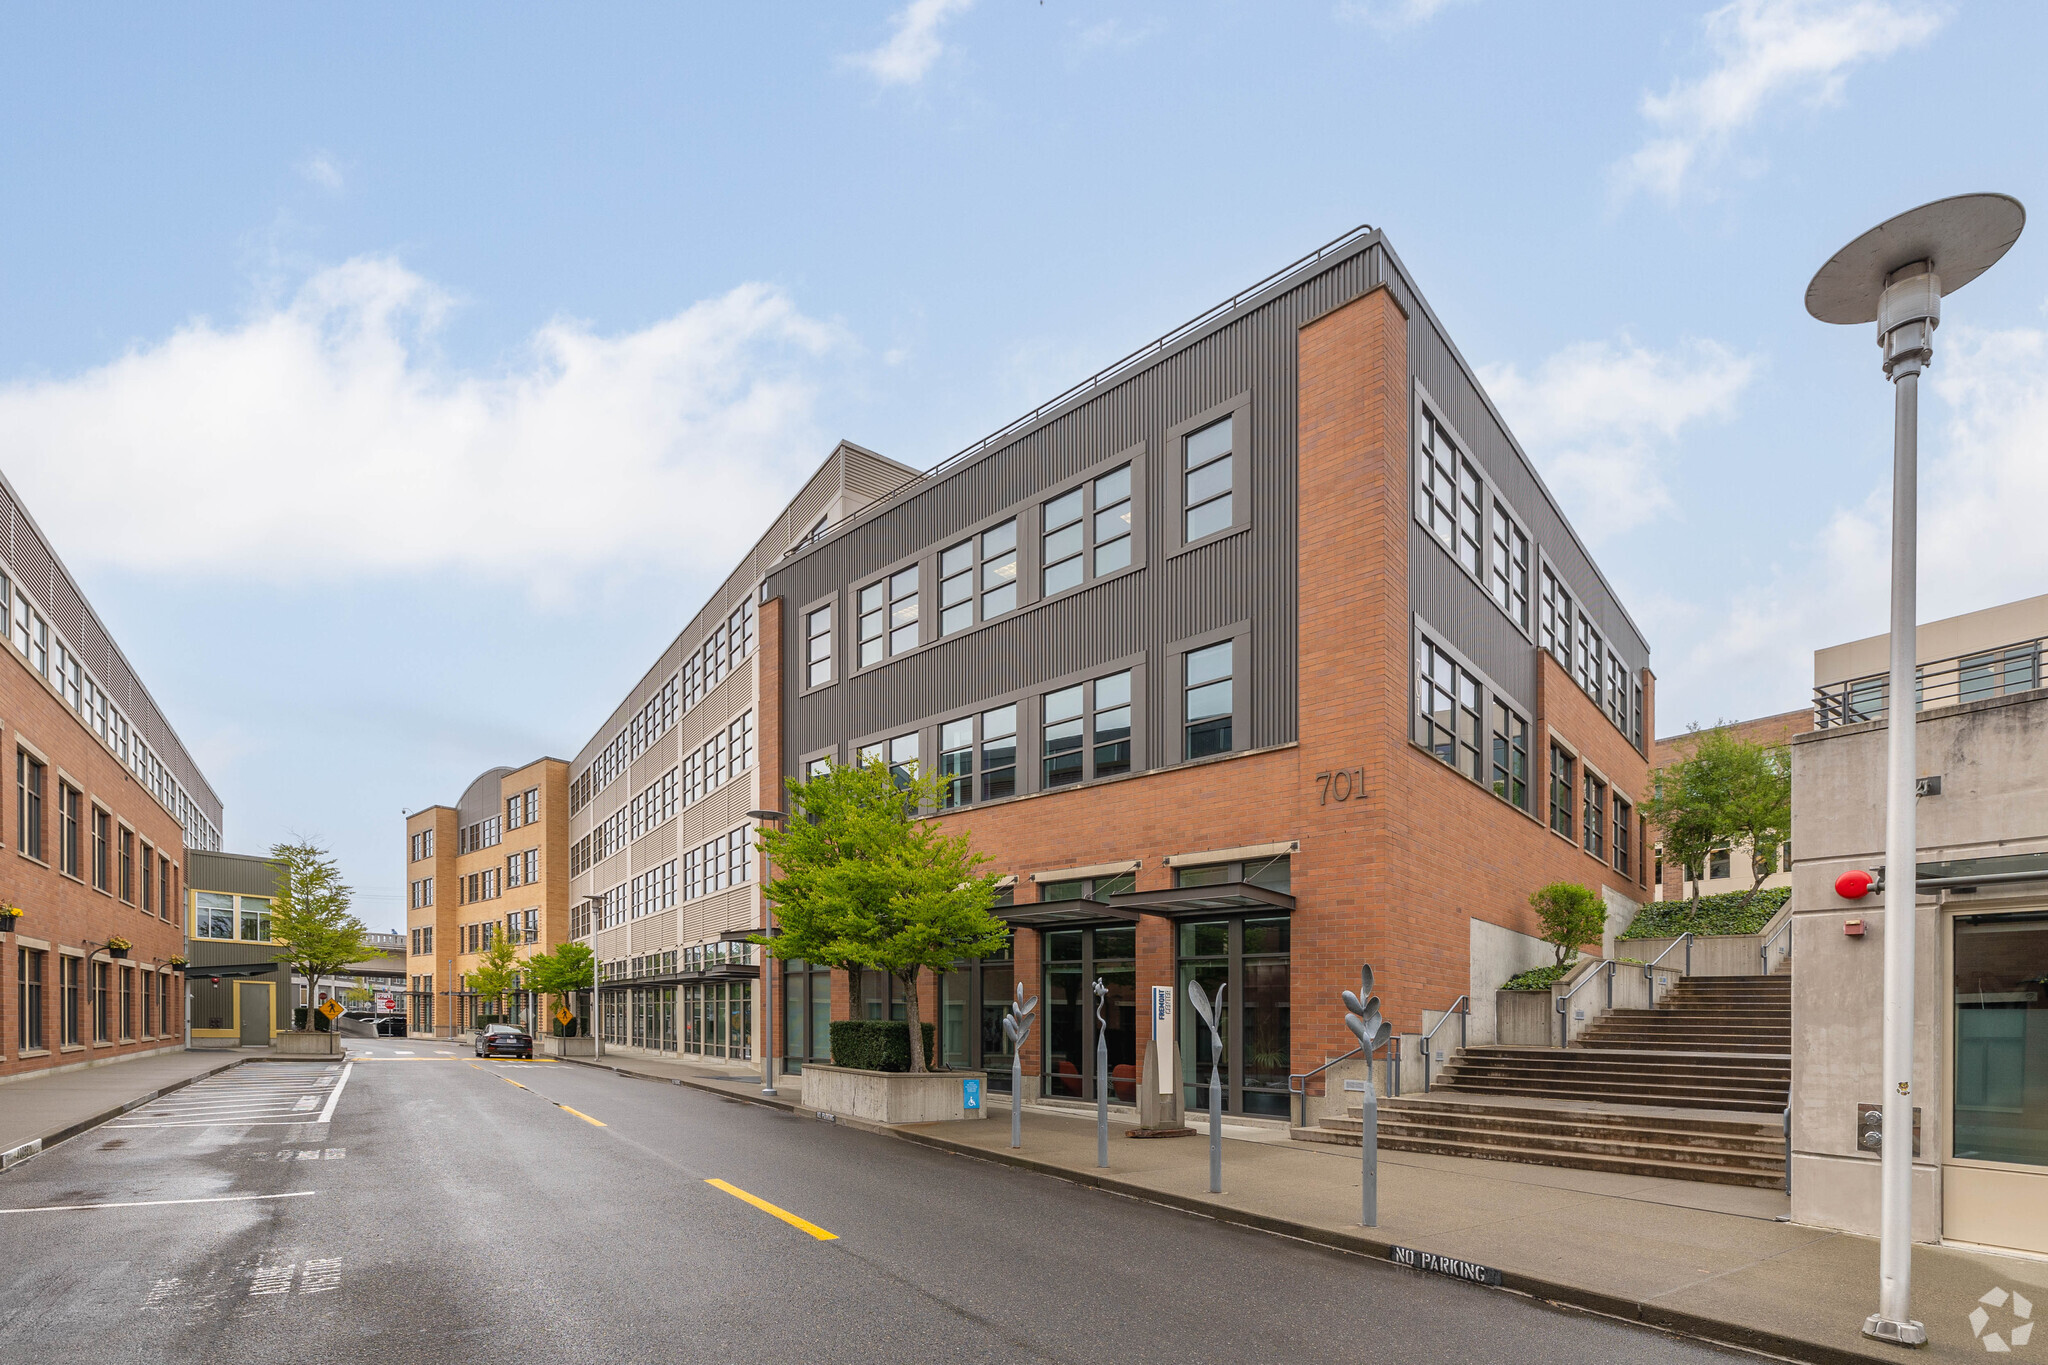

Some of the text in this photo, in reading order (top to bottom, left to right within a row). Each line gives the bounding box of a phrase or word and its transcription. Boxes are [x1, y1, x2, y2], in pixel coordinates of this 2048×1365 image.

[1316, 766, 1368, 806] 701
[1396, 1247, 1485, 1281] NO PARKING
